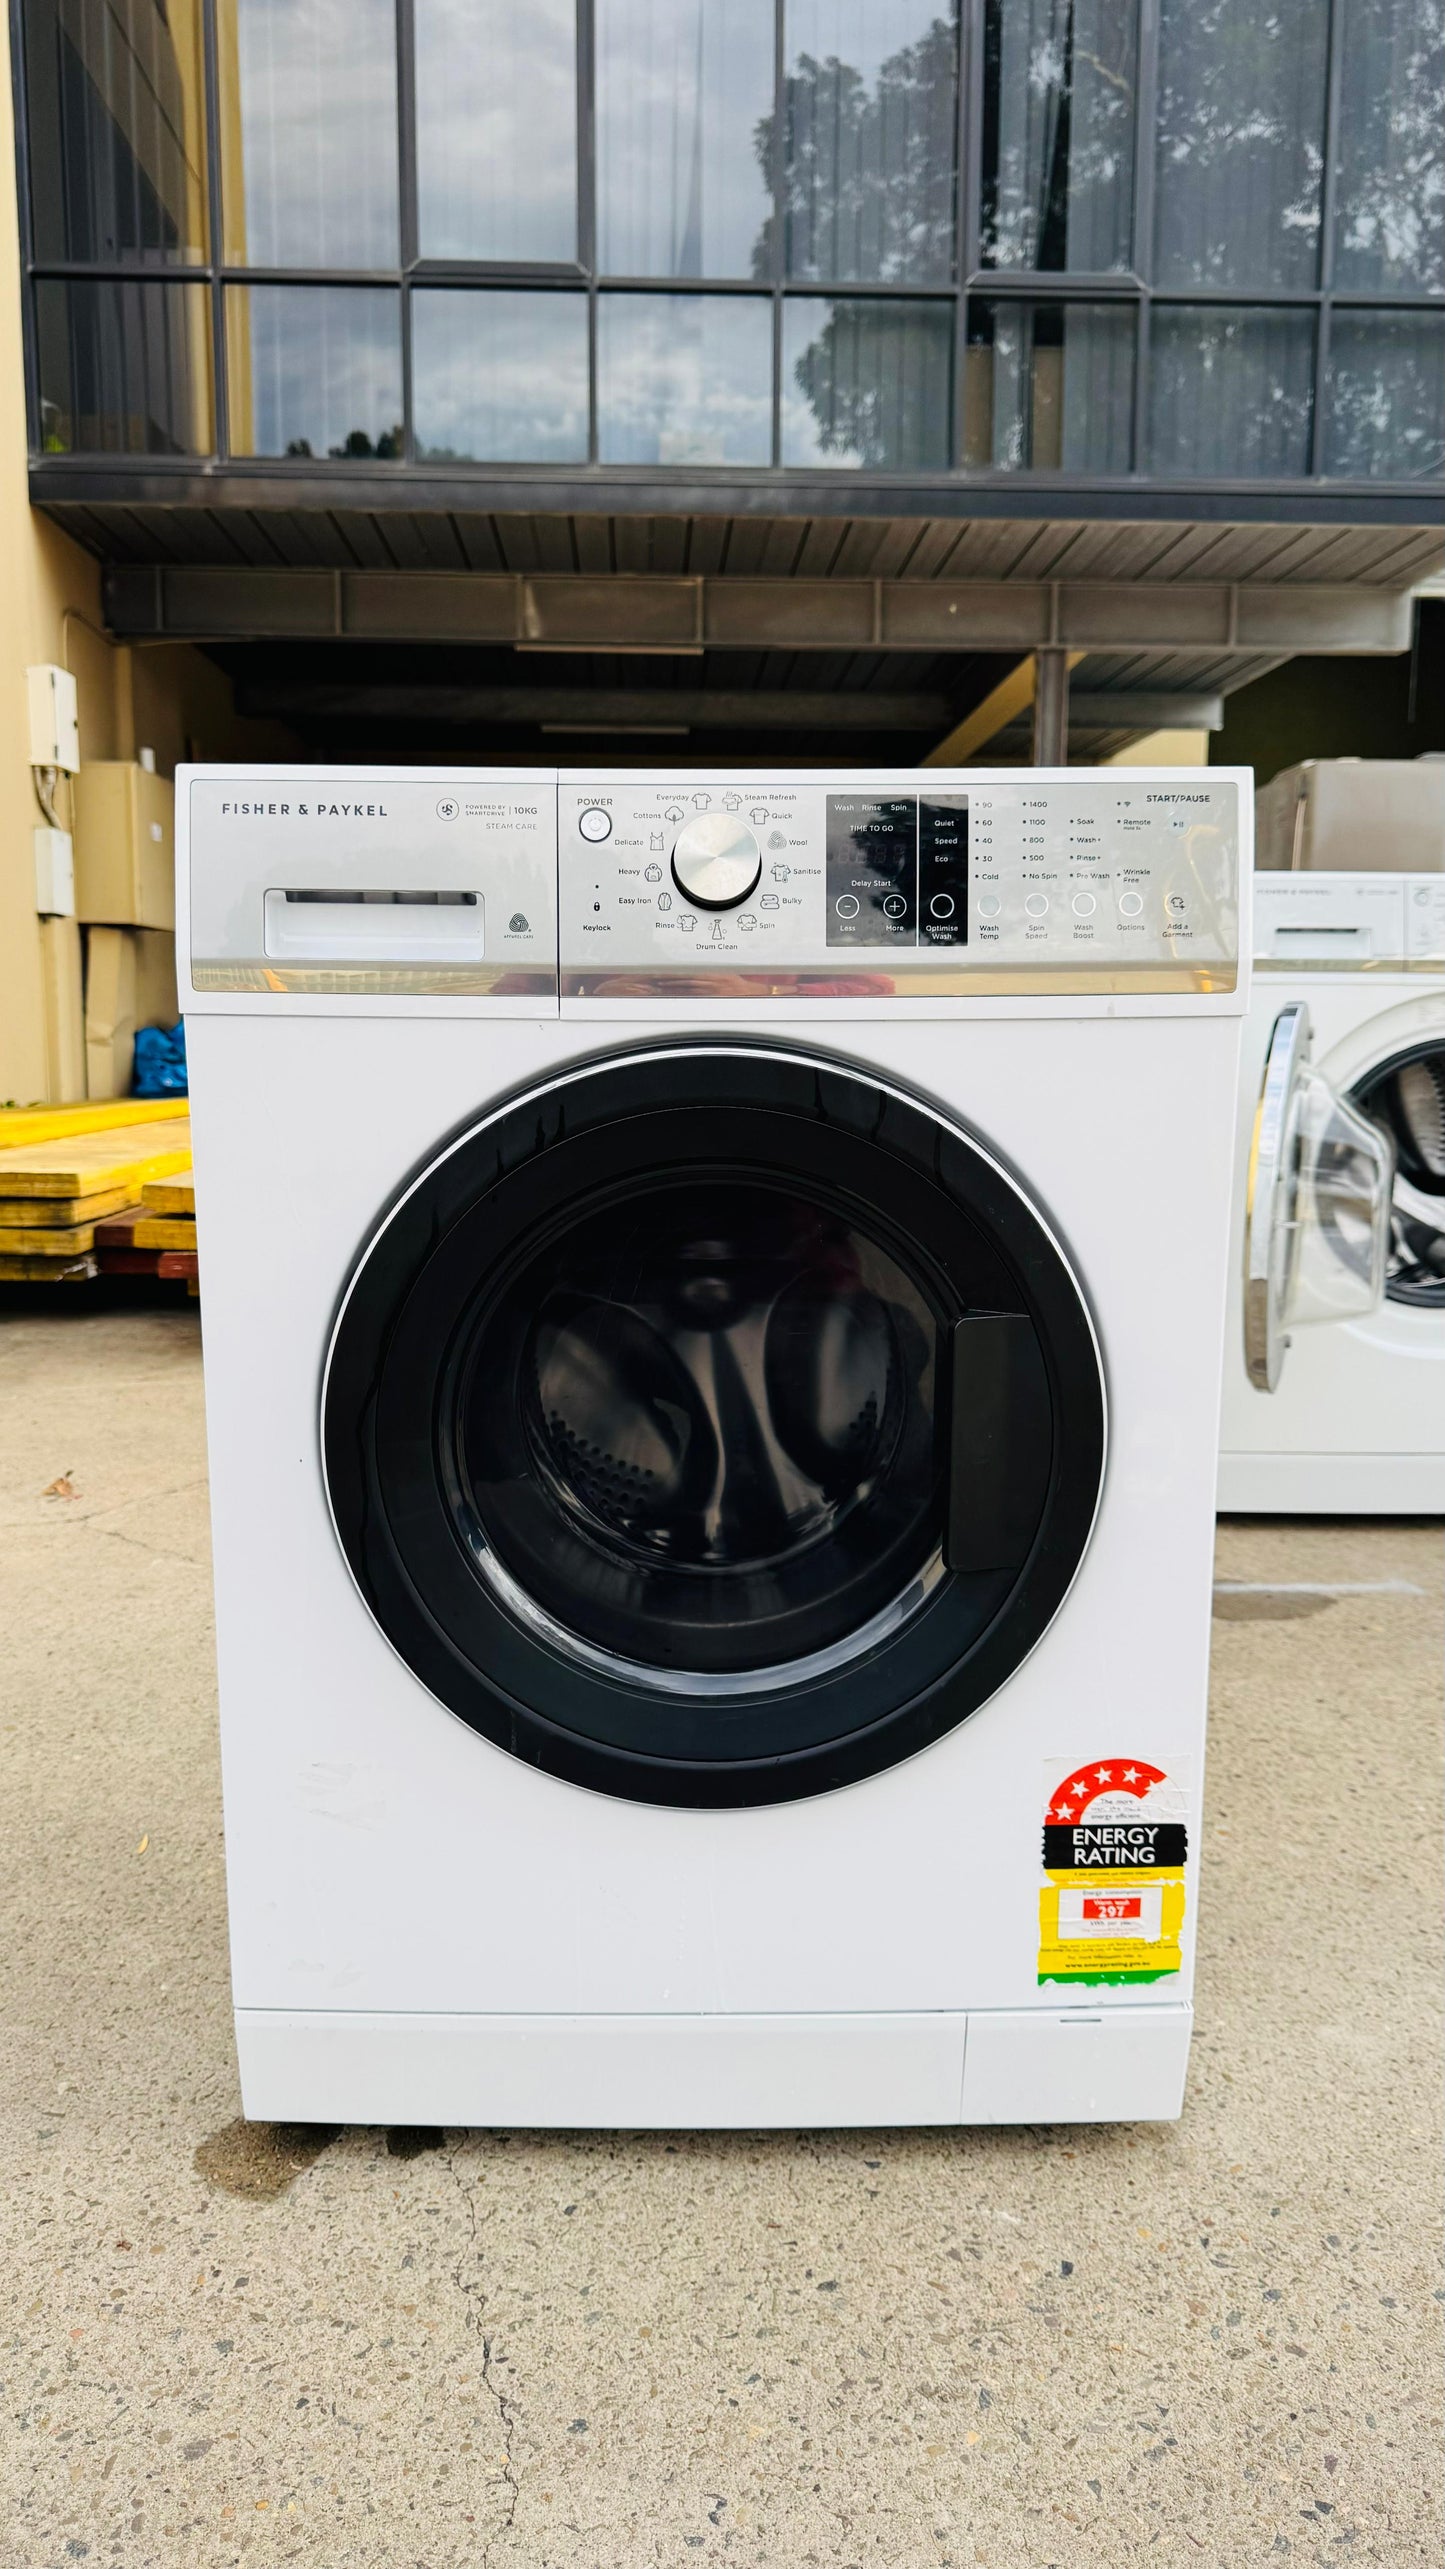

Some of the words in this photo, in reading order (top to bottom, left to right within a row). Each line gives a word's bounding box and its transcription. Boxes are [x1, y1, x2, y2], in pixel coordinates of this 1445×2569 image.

[577, 798, 614, 806] POWER
[656, 794, 690, 802] Everyday
[1146, 794, 1211, 803] START/PAUSE
[222, 803, 290, 815] FISHER
[298, 804, 309, 815] &
[317, 804, 388, 816] PAYKEL
[890, 804, 907, 812] Spin
[772, 812, 793, 820] Quick
[934, 838, 958, 846] Speed
[1040, 873, 1058, 881] Spin
[851, 880, 872, 888] Delay
[760, 922, 776, 930] Spin
[1028, 924, 1045, 932] Spin
[1025, 932, 1048, 940] Speed
[1072, 1827, 1160, 1846] ENERGY
[1074, 1847, 1156, 1865] RATING
[1098, 1905, 1125, 1918] 297
